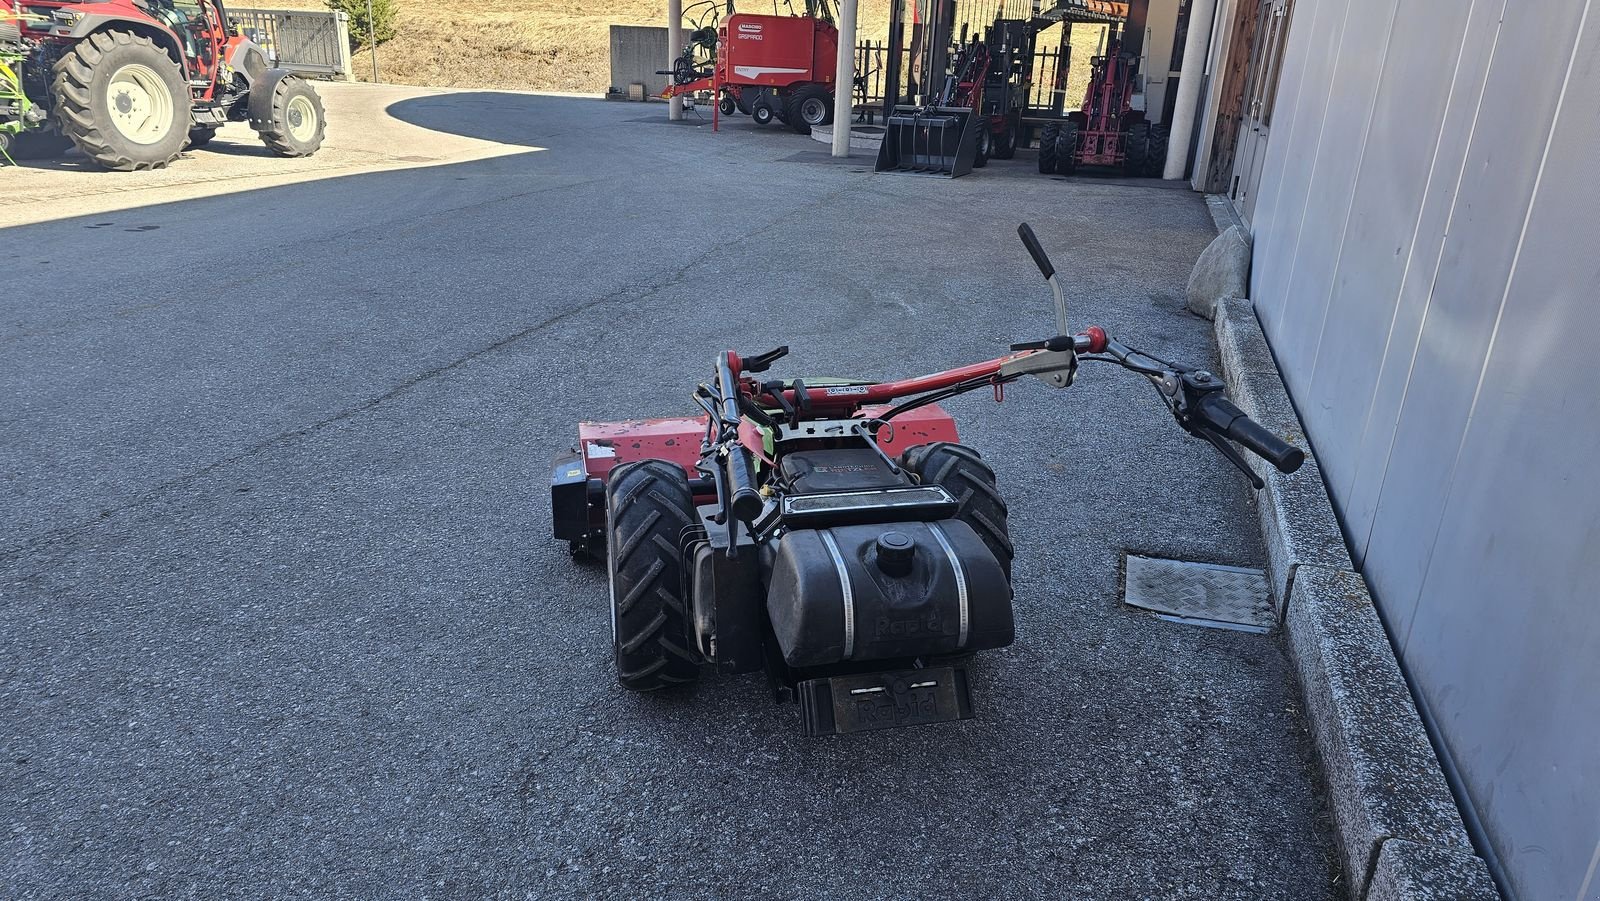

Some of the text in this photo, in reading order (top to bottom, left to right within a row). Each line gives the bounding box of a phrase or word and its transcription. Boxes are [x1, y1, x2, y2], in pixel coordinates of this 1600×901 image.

[738, 33, 763, 41] GASPARDO
[873, 609, 943, 638] Rapid
[857, 692, 937, 725] Rapid
